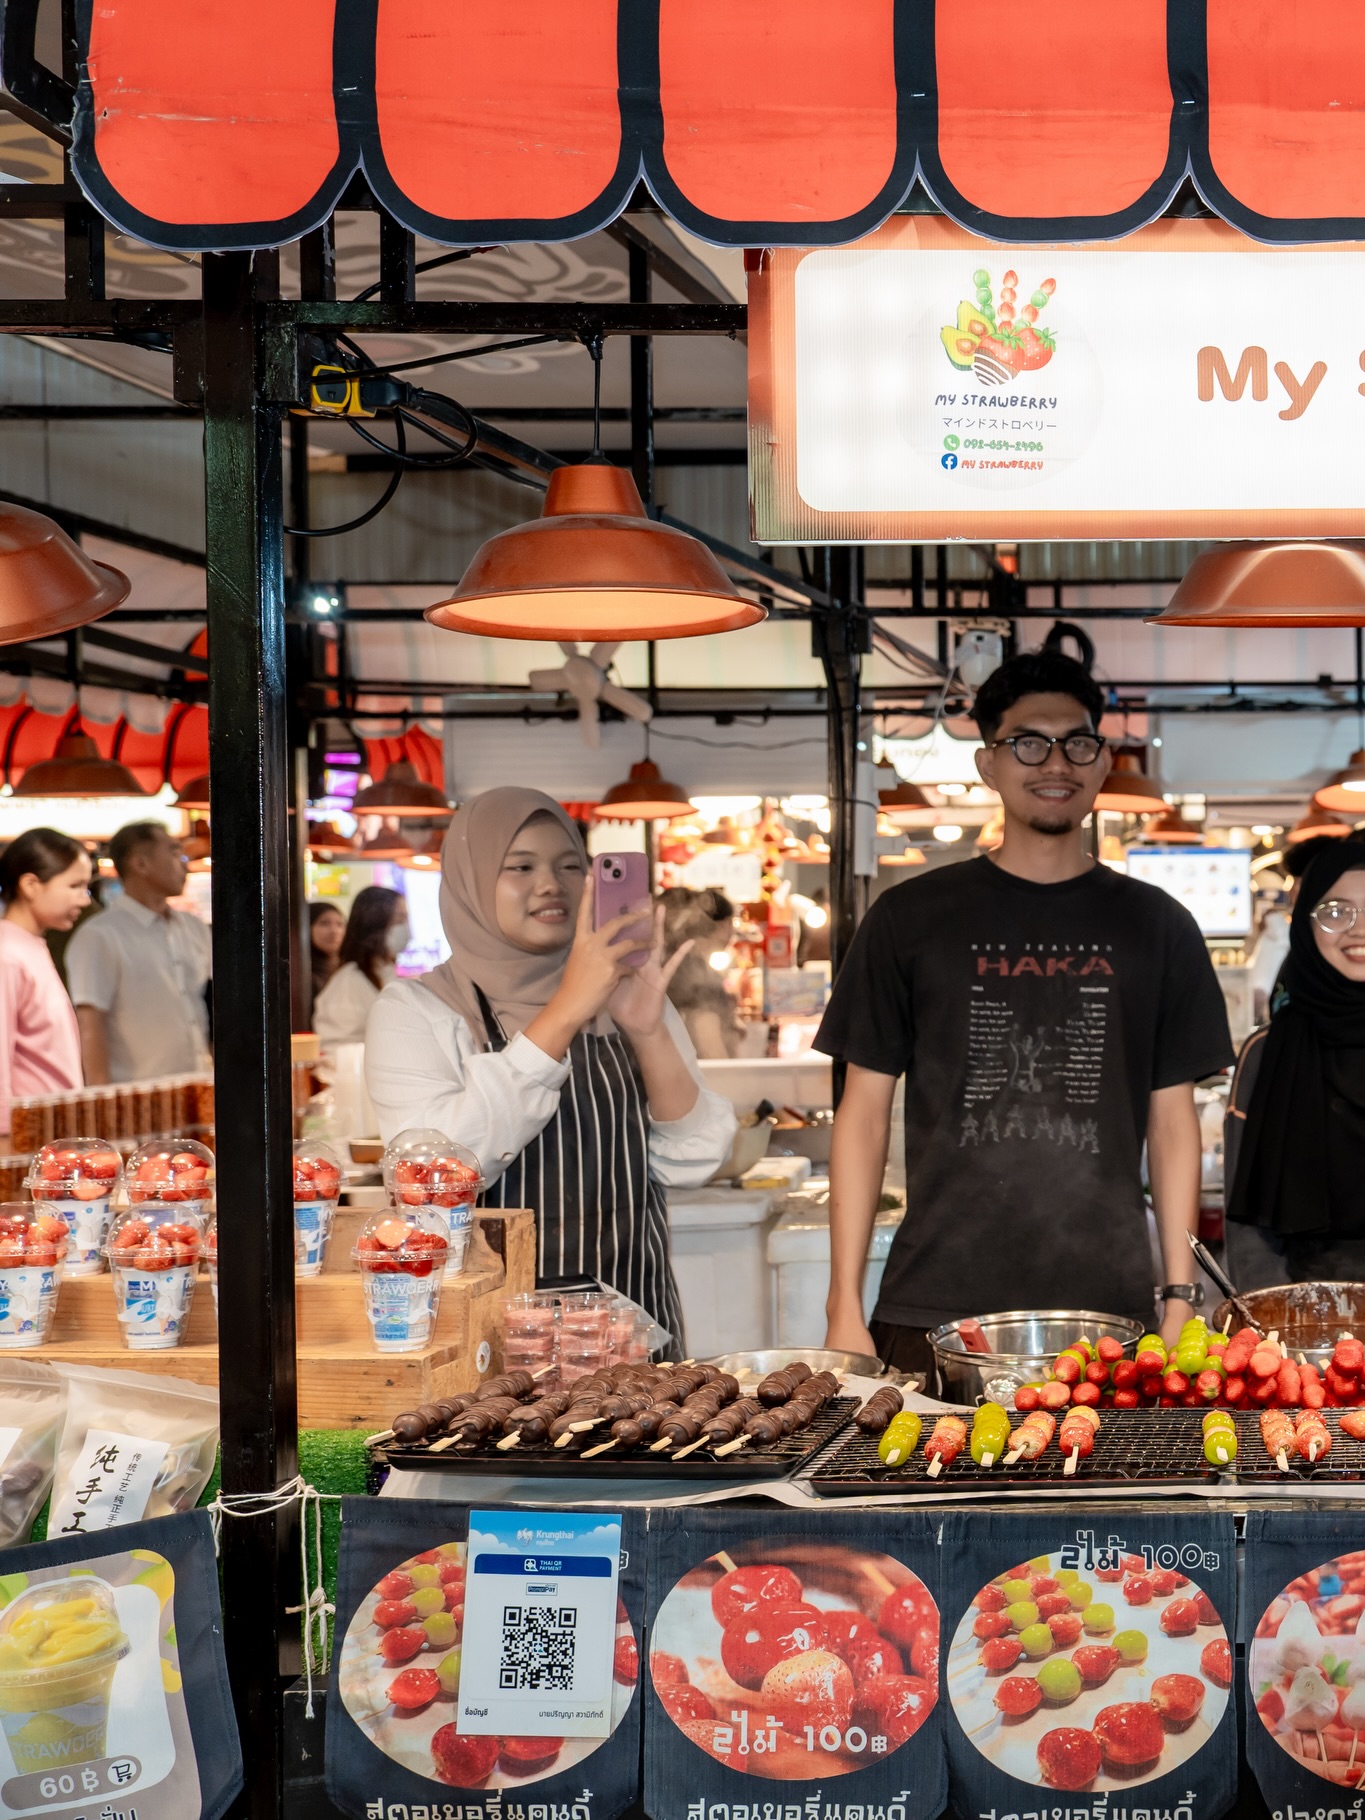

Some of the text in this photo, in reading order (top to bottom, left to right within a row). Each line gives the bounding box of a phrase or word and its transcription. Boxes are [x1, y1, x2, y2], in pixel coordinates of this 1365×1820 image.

[1196, 345, 1328, 422] My
[935, 393, 1057, 409] MY STRAWBERRY
[942, 416, 1057, 431] マインドストロベリー
[963, 438, 1044, 452] 092-654-2496
[961, 460, 1044, 470] MY STRAWBERRY
[1025, 943, 1113, 951] ZEALAND
[977, 956, 1115, 977] HAKA
[61, 1444, 120, 1533] 纯手工
[536, 1529, 574, 1541] Krungthai
[712, 1710, 783, 1755] 2ไม้
[39, 1767, 100, 1799] 60 ฿
